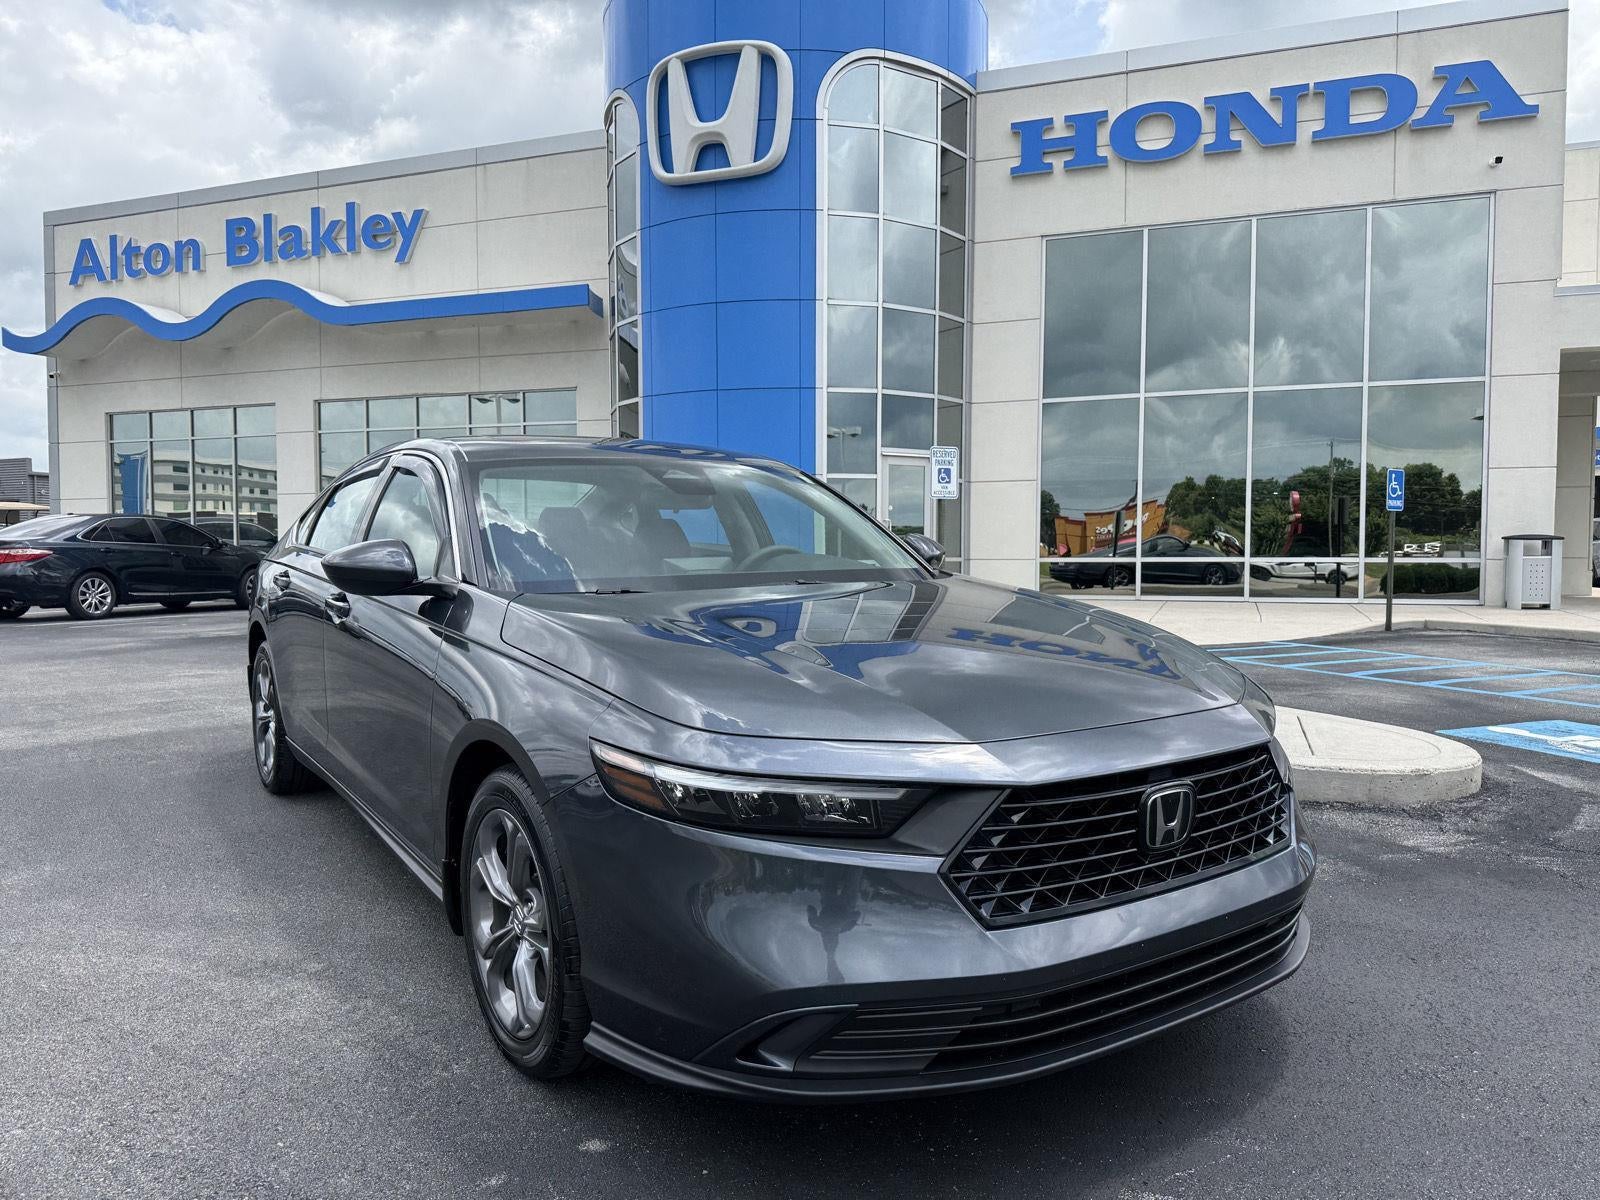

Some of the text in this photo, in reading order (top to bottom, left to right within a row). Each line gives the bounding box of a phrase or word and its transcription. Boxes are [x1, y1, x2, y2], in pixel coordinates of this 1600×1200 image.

[1009, 59, 1540, 178] HONDA
[68, 201, 430, 288] Alton Blakley
[932, 449, 957, 459] RESERVED
[934, 459, 955, 467] PARKING
